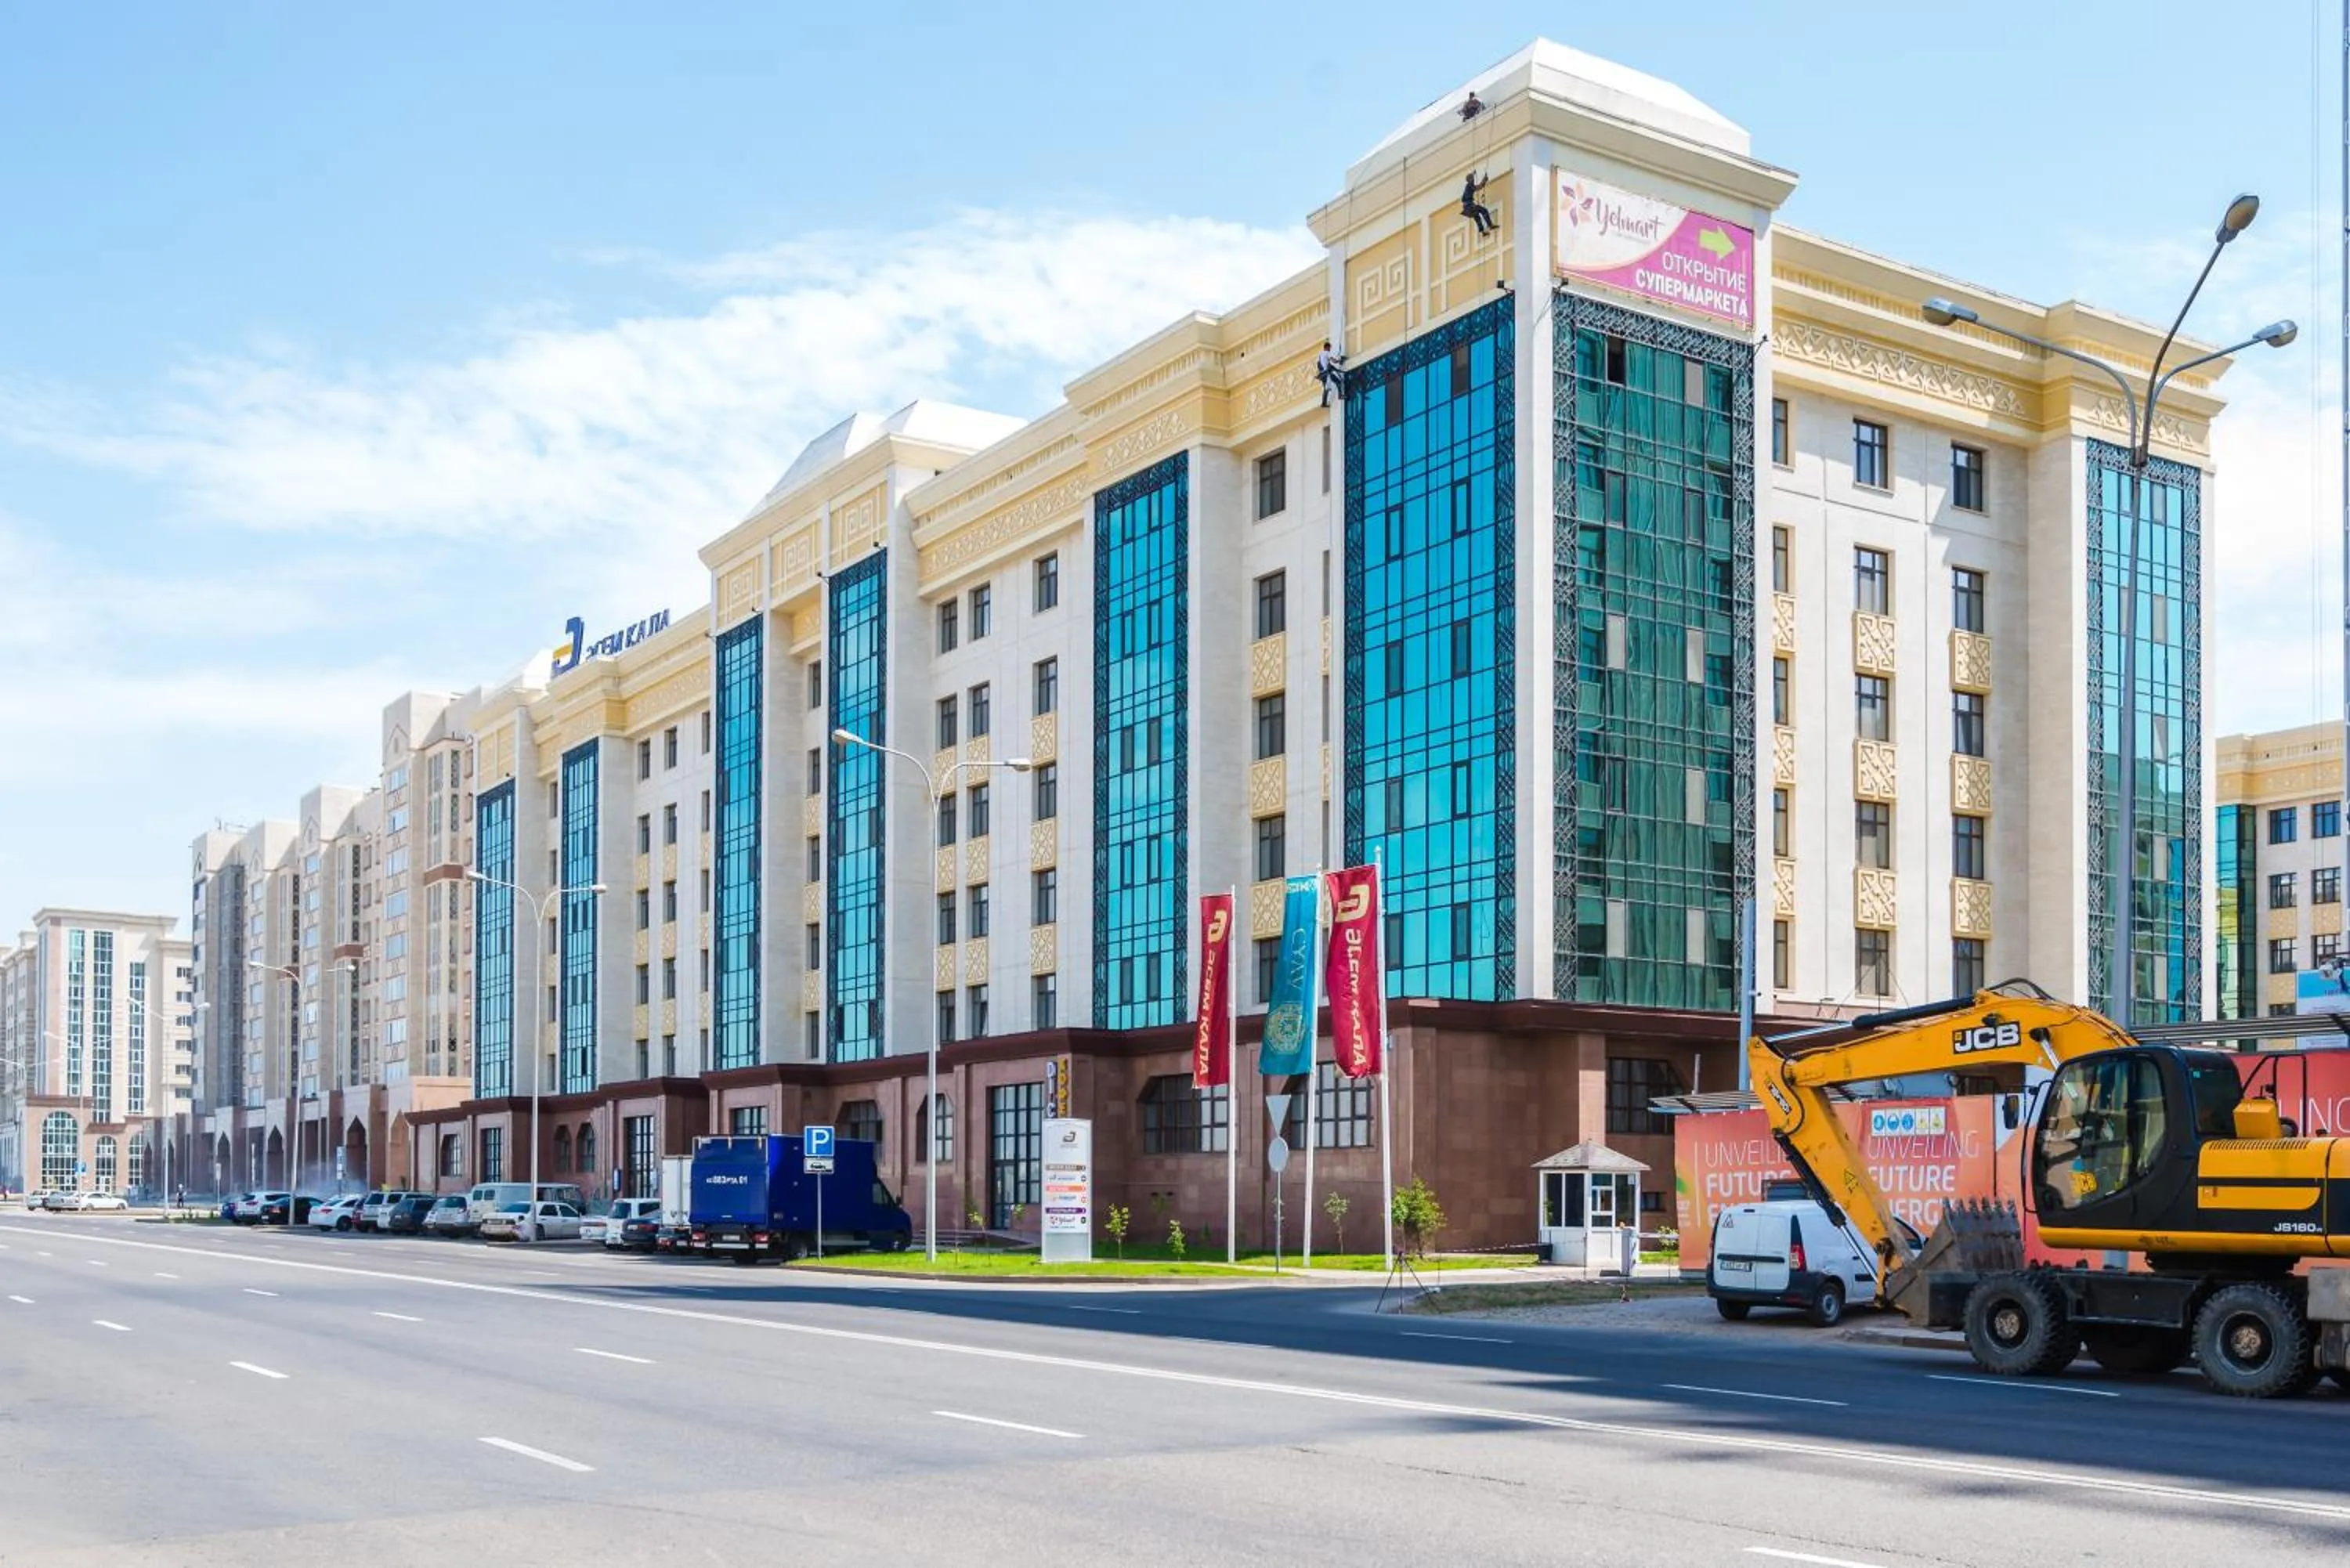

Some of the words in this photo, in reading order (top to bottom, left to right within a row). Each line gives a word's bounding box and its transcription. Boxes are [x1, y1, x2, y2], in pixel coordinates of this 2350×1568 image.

[1661, 251, 1747, 294] ОТКРЫТИЕ
[1635, 269, 1748, 317] СУПЕРМАРКЕТА
[1954, 1024, 2020, 1053] JCB
[812, 1129, 830, 1154] P
[1867, 1130, 1980, 1160] UNVEILING
